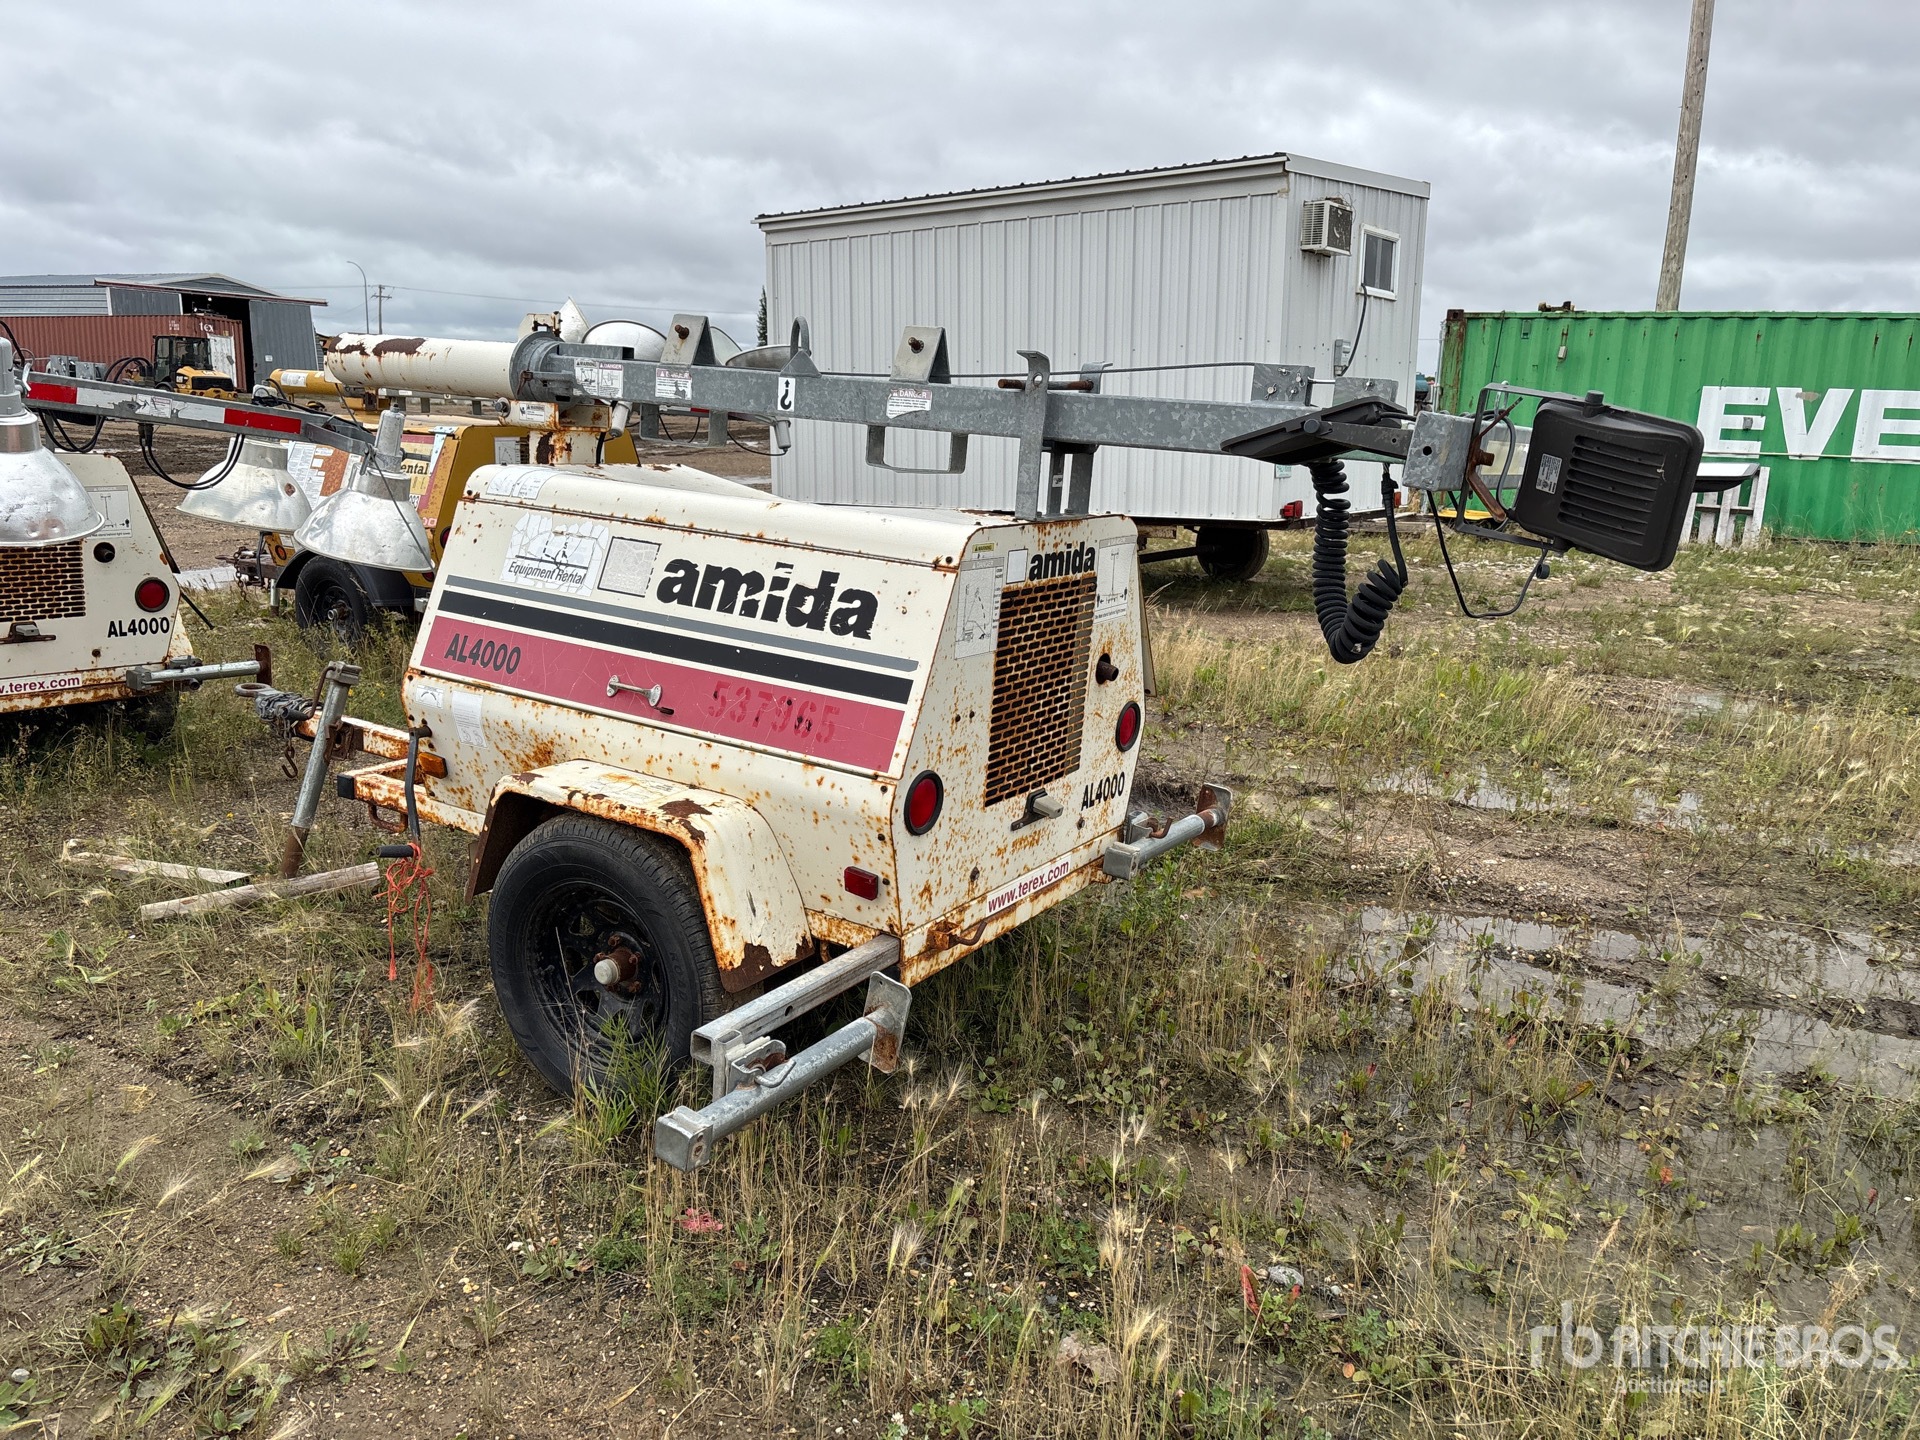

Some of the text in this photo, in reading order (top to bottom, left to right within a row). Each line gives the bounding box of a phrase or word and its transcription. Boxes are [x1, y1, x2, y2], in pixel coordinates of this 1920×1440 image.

[401, 463, 429, 475] ental
[508, 561, 587, 586] Equipment Rental
[1029, 541, 1095, 581] amida
[656, 558, 878, 640] amida
[107, 617, 170, 638] AL4000
[444, 633, 521, 675] AL4000
[708, 681, 841, 744] 537965
[1081, 771, 1125, 811] AL4000
[988, 861, 1069, 913] www.terex.com
